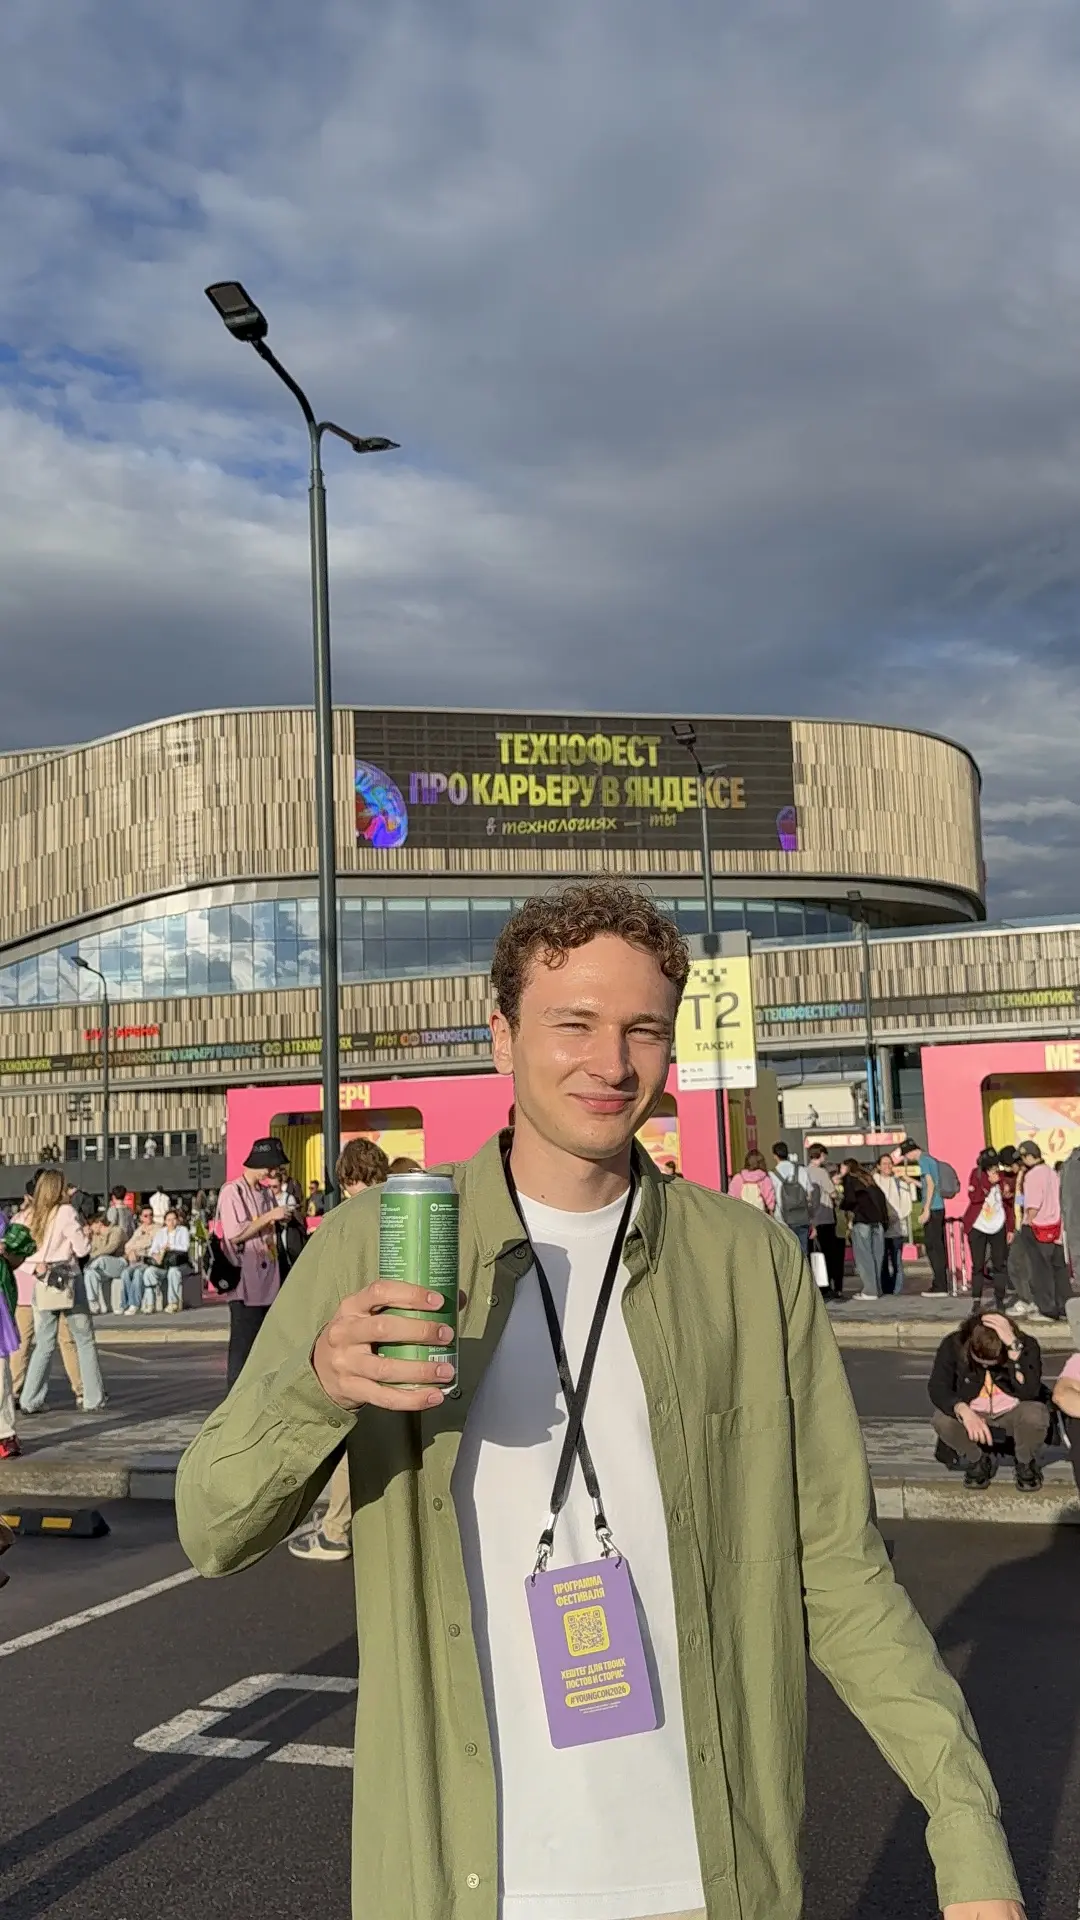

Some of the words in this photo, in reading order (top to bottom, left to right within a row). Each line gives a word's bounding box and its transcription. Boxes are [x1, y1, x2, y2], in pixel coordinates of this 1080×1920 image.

[496, 733, 662, 767] ТЕХНОФЕСТ
[410, 771, 468, 805] ПРО
[472, 772, 596, 808] КАРЬЕРУ
[602, 775, 621, 808] В
[624, 776, 747, 812] ЯНДЕКСЕ
[502, 816, 617, 836] технологиях
[649, 811, 678, 828] ты
[695, 1040, 735, 1052] ТАКСИ
[553, 1576, 603, 1595] ПРОГРАММА
[556, 1588, 605, 1607] ФЕСТИВАЛЯ
[560, 1665, 588, 1681] ХЕШТЕГ
[566, 1675, 592, 1689] ПОСТОВ
[598, 1668, 625, 1683] СТОРИС
[570, 1687, 627, 1704] #YOUNGCON2026
